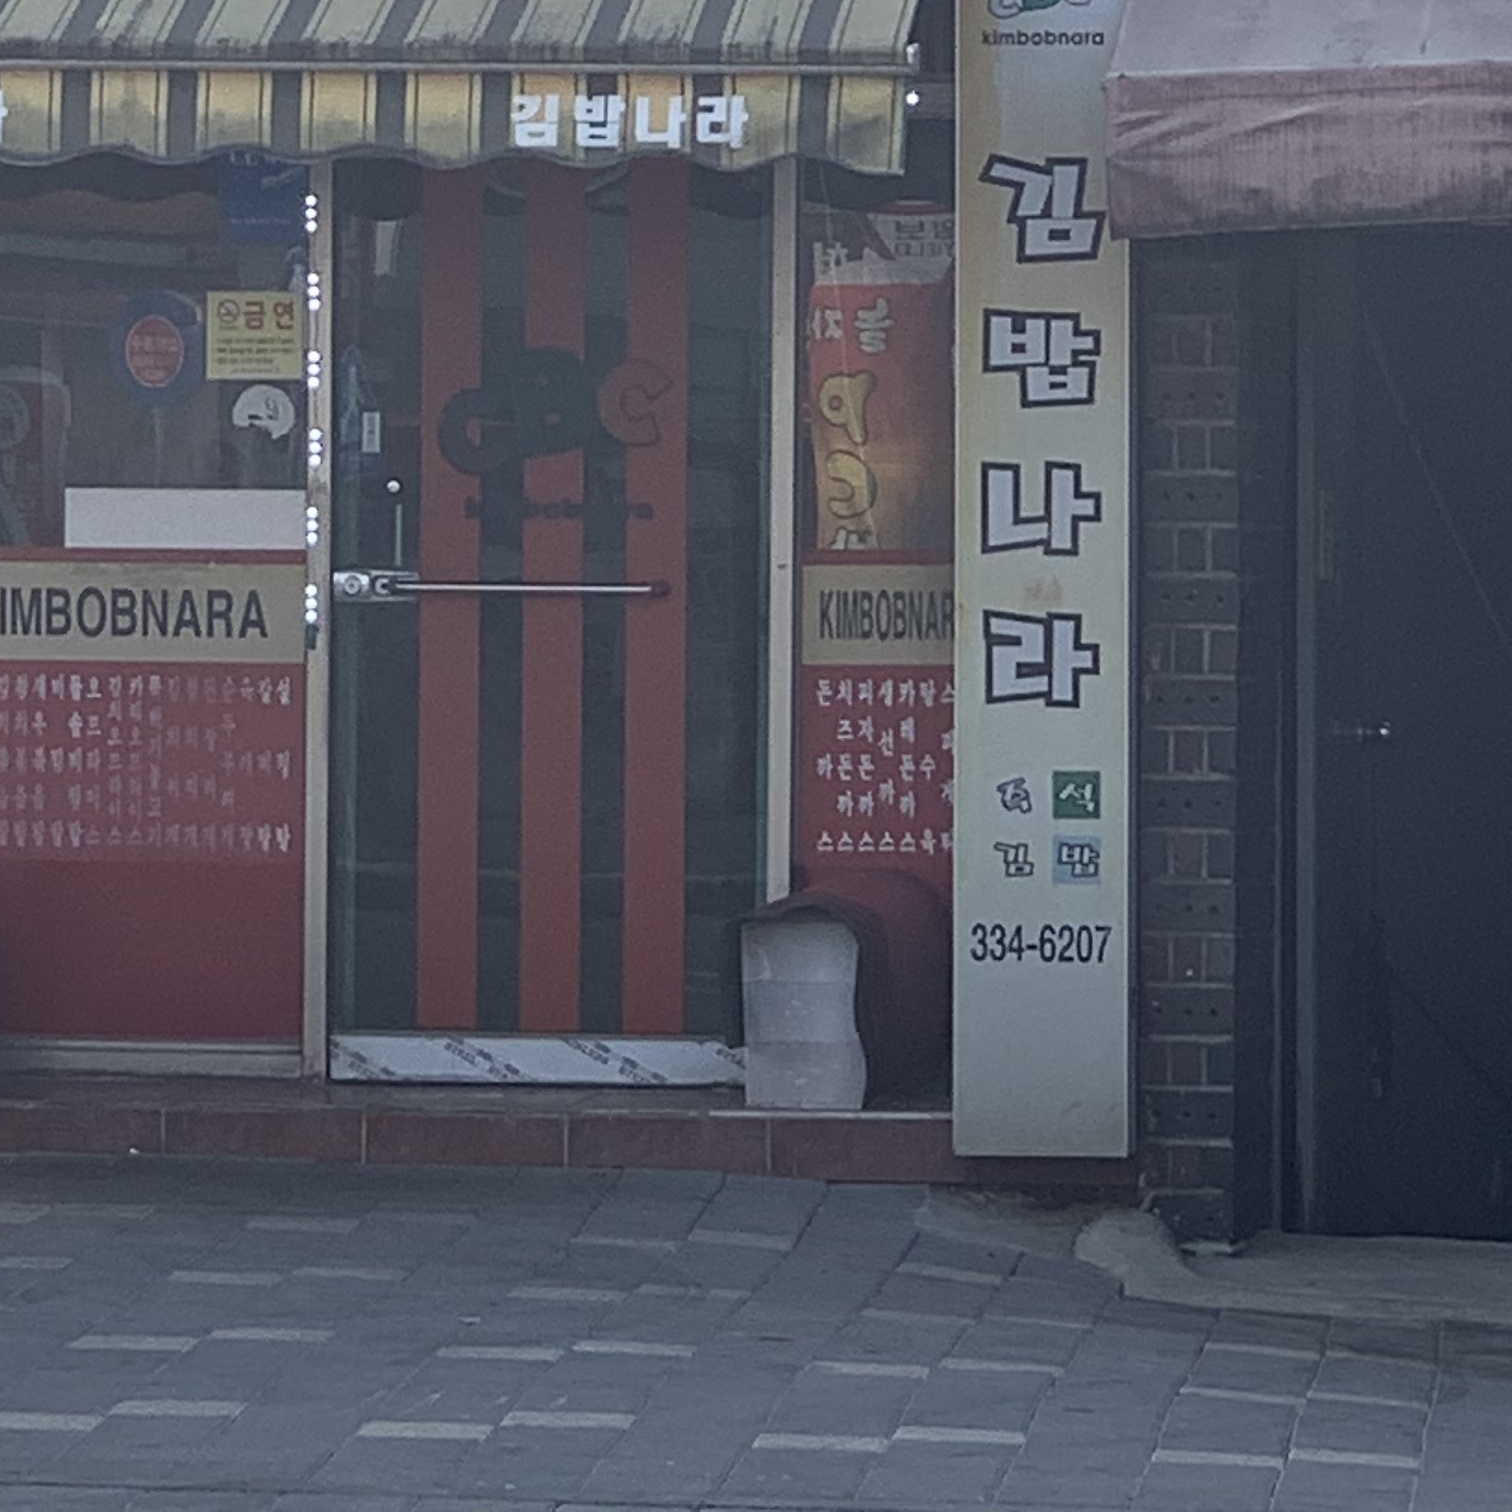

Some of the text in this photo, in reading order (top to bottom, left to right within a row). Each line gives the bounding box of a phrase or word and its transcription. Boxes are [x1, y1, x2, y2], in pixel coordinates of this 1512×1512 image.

[981, 29, 1105, 46] kimbobnara
[510, 93, 749, 149] 김밥나라
[978, 153, 1107, 708] 김밥나라
[969, 913, 1113, 964] 334-6207
